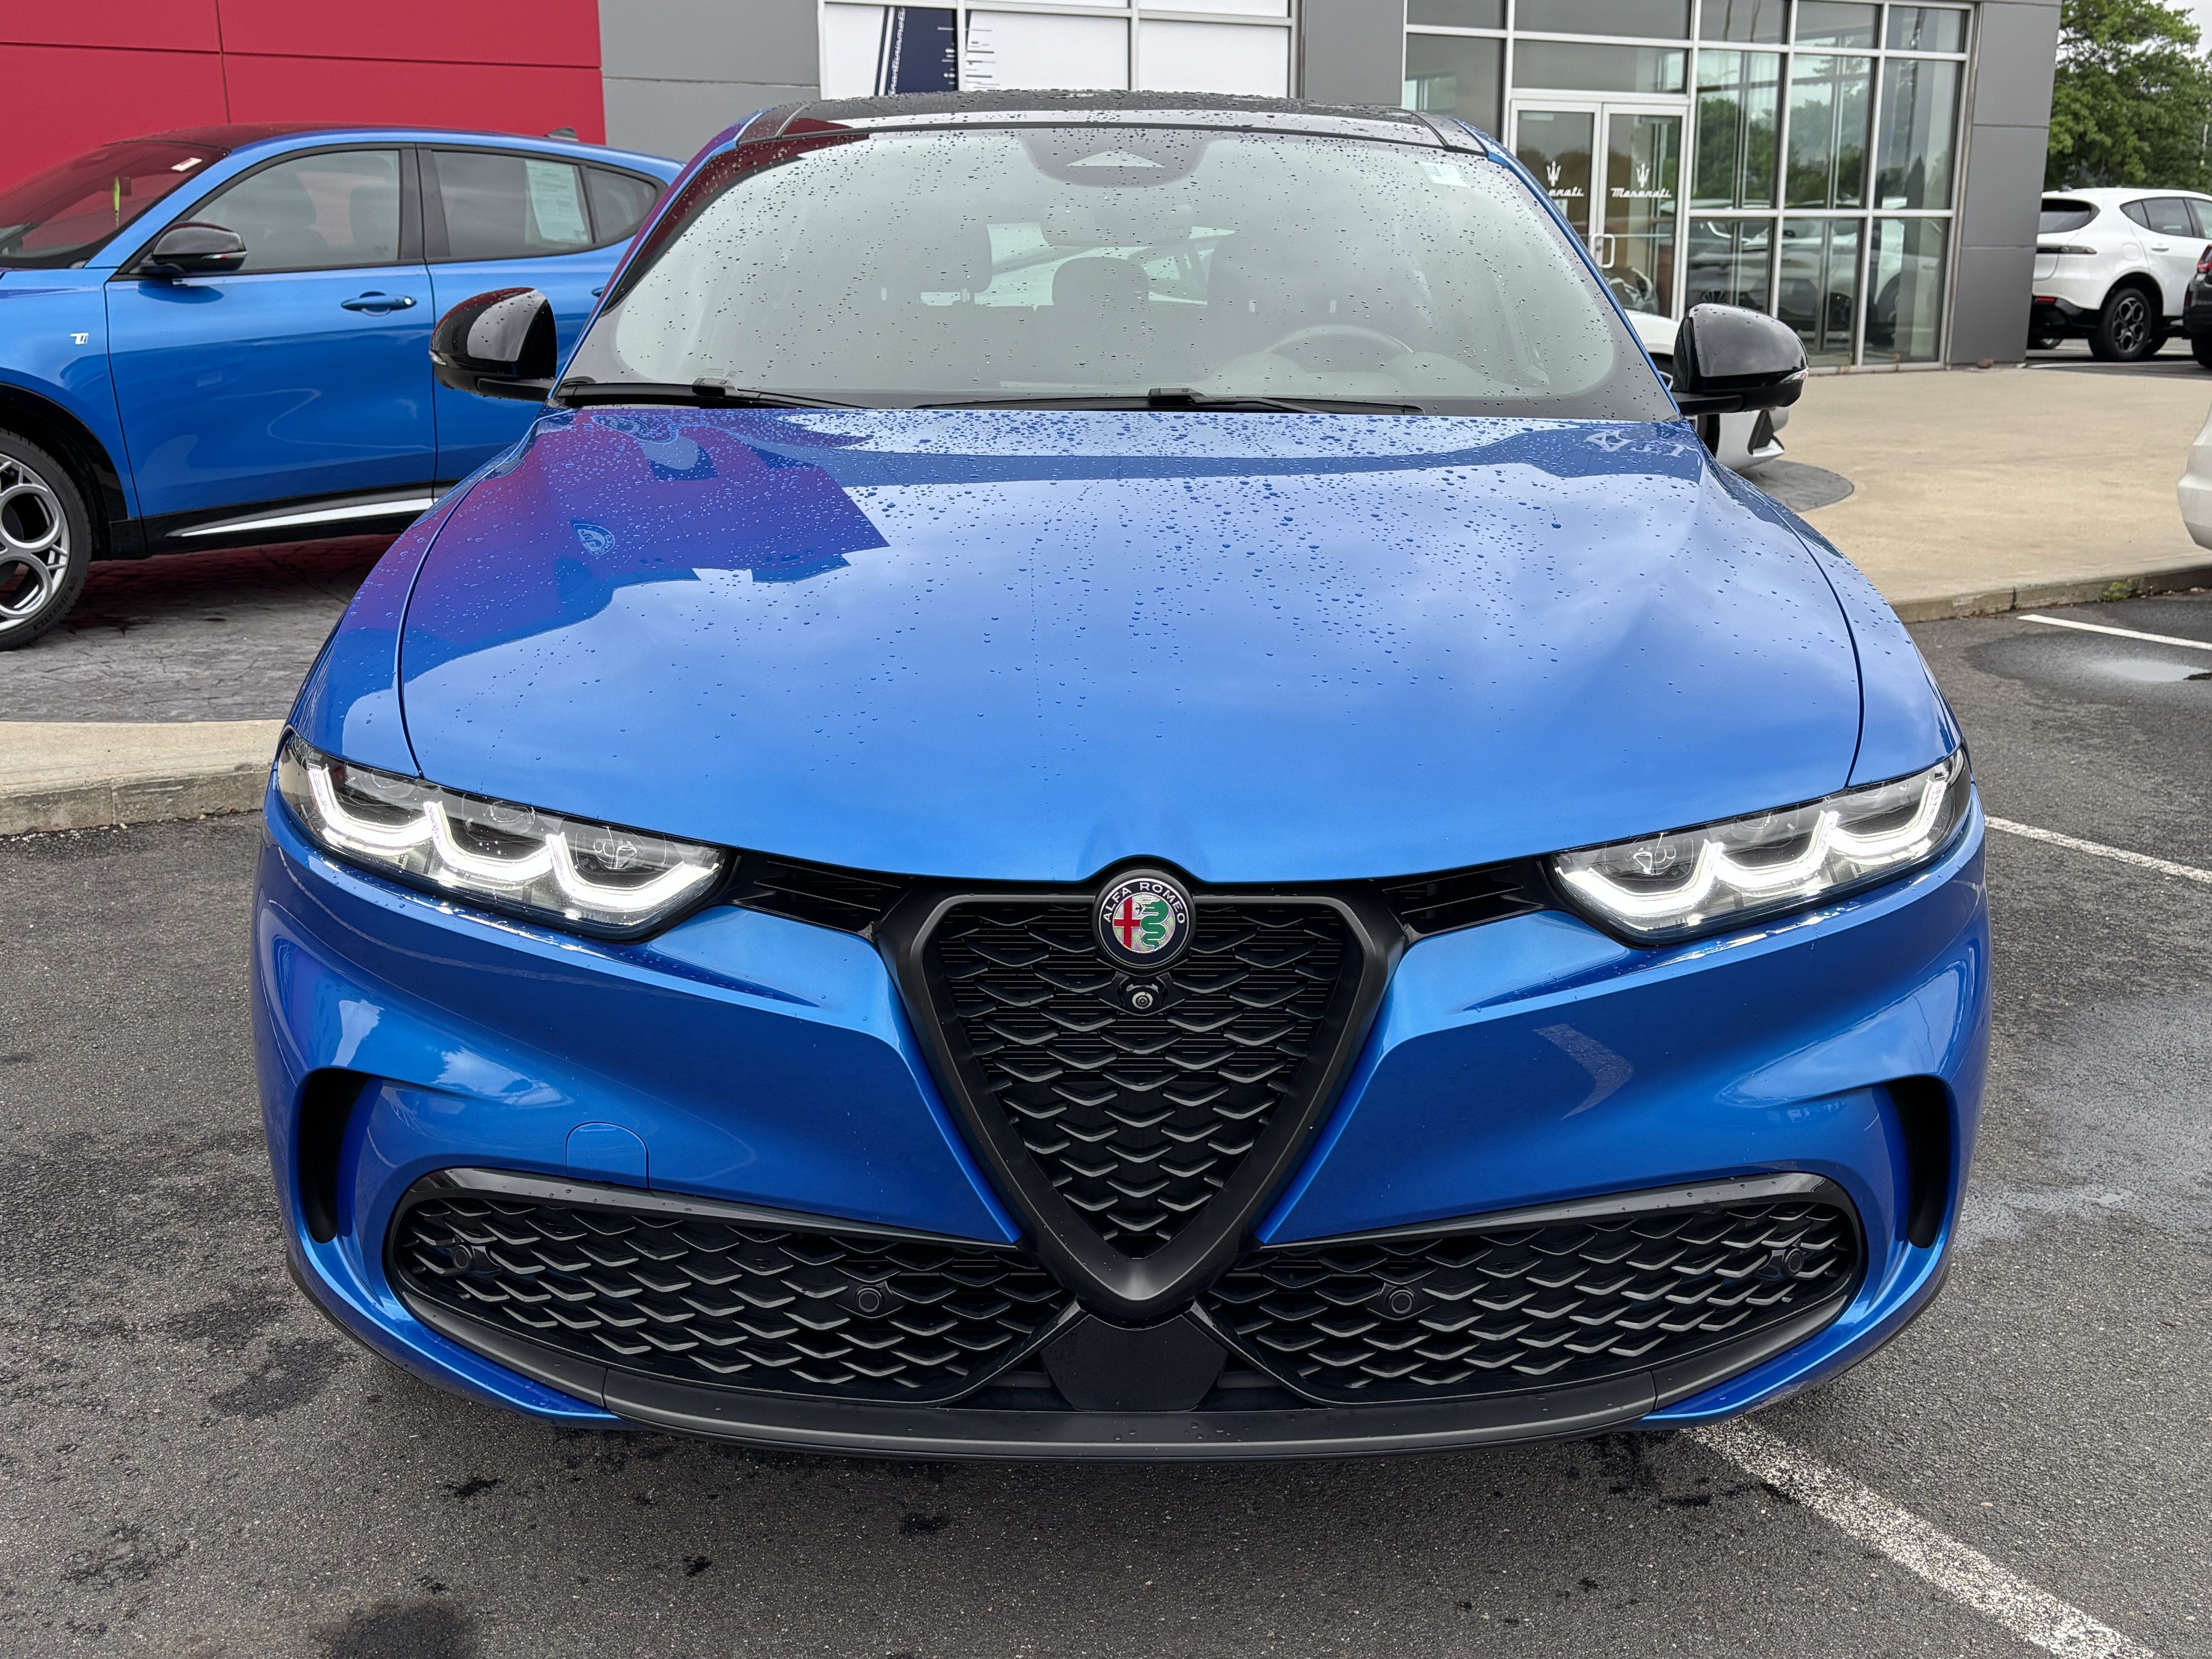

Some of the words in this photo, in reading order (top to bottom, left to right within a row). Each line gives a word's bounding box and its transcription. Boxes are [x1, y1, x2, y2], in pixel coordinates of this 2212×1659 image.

[1549, 186, 1584, 197] erati
[1611, 187, 1672, 198] Maserati
[1103, 887, 1132, 923] ALFA
[1139, 882, 1185, 924] ROMEO
